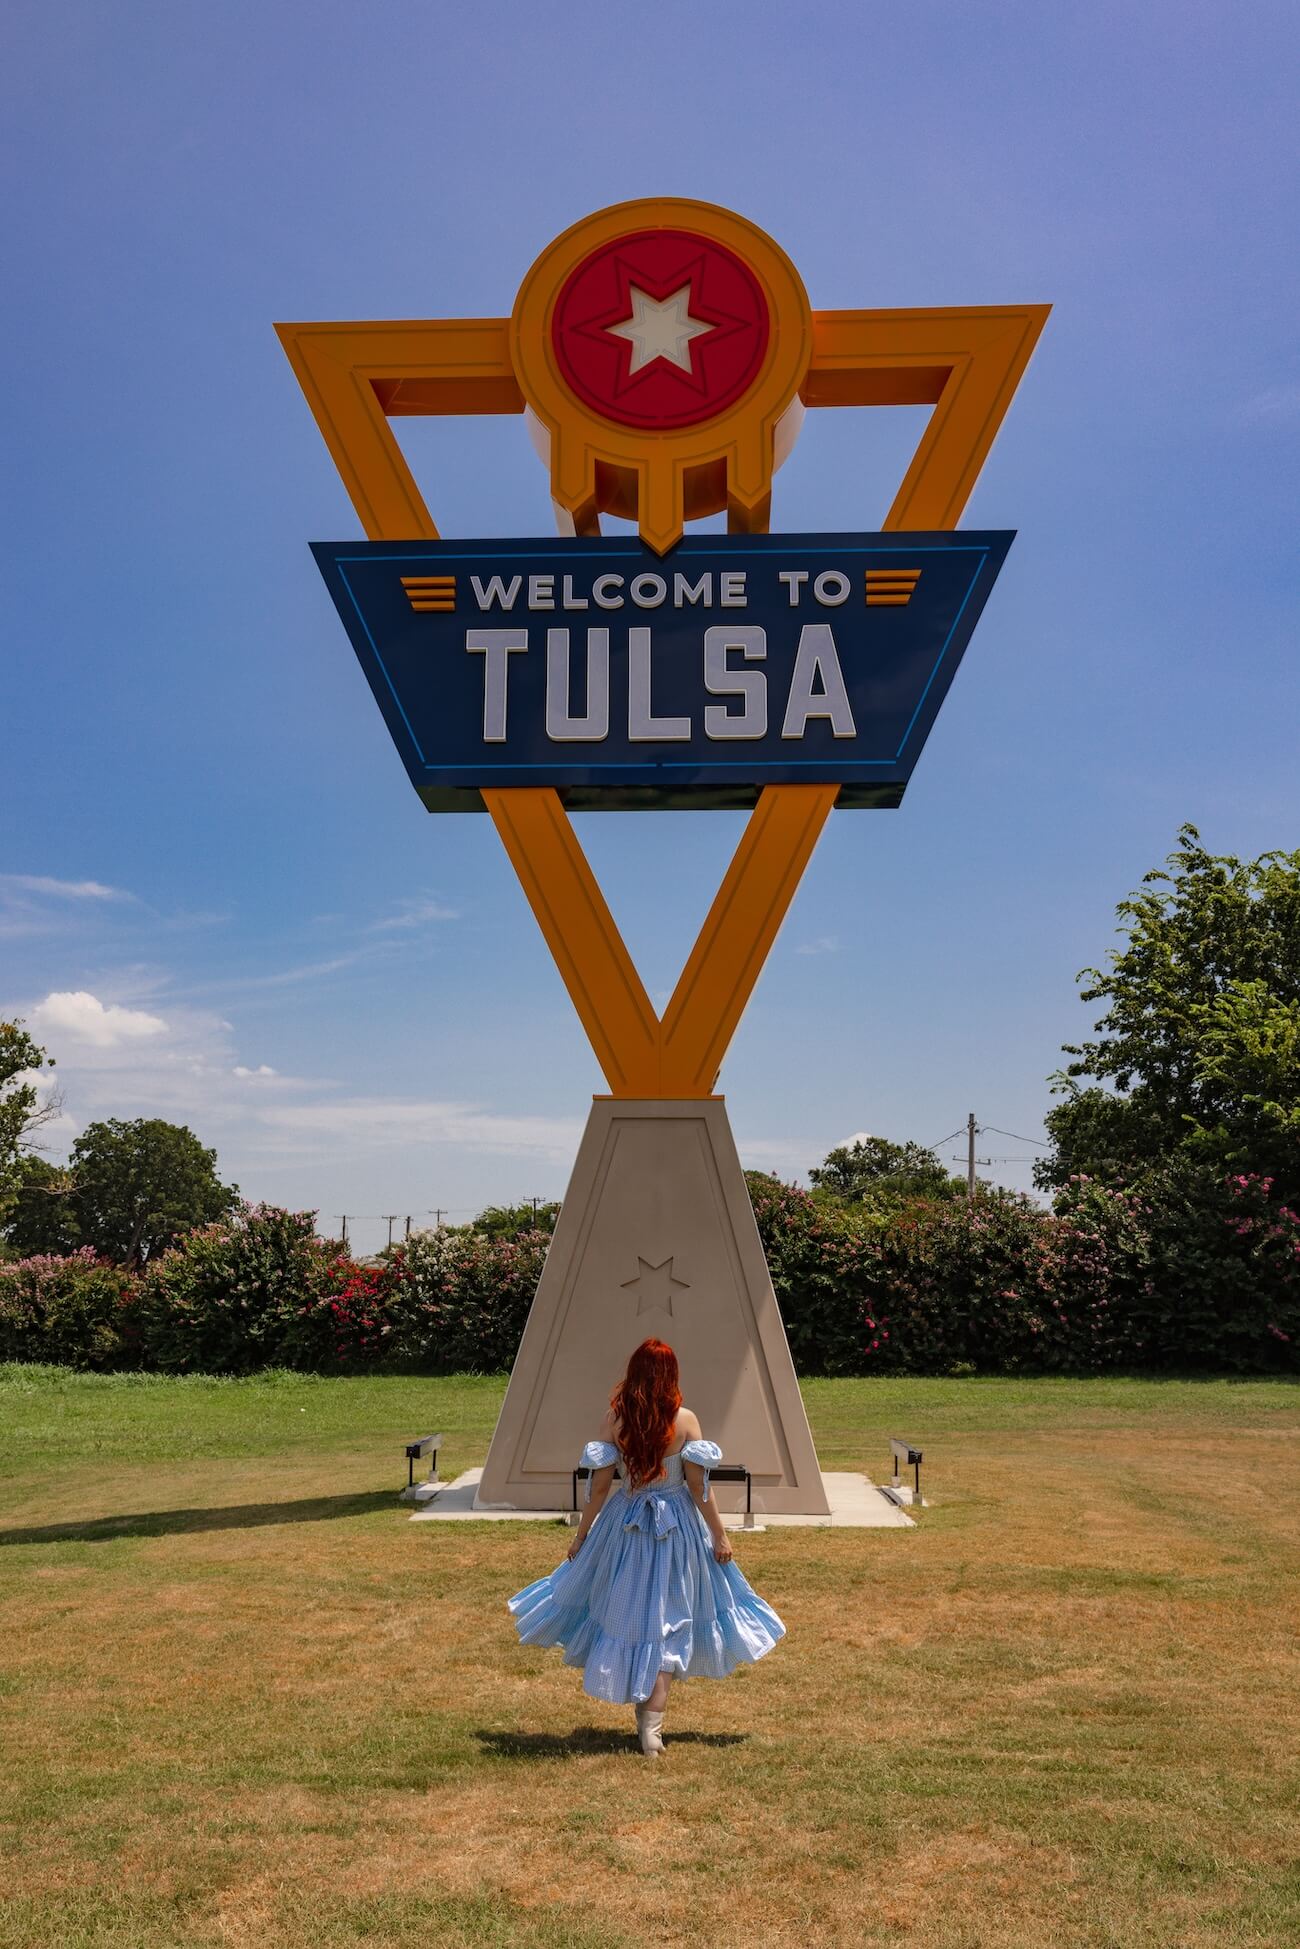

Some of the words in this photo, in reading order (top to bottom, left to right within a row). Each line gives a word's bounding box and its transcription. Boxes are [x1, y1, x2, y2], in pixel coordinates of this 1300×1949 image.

[470, 571, 749, 611] WELCOME
[778, 569, 852, 607] TO
[465, 623, 858, 743] TULSA
